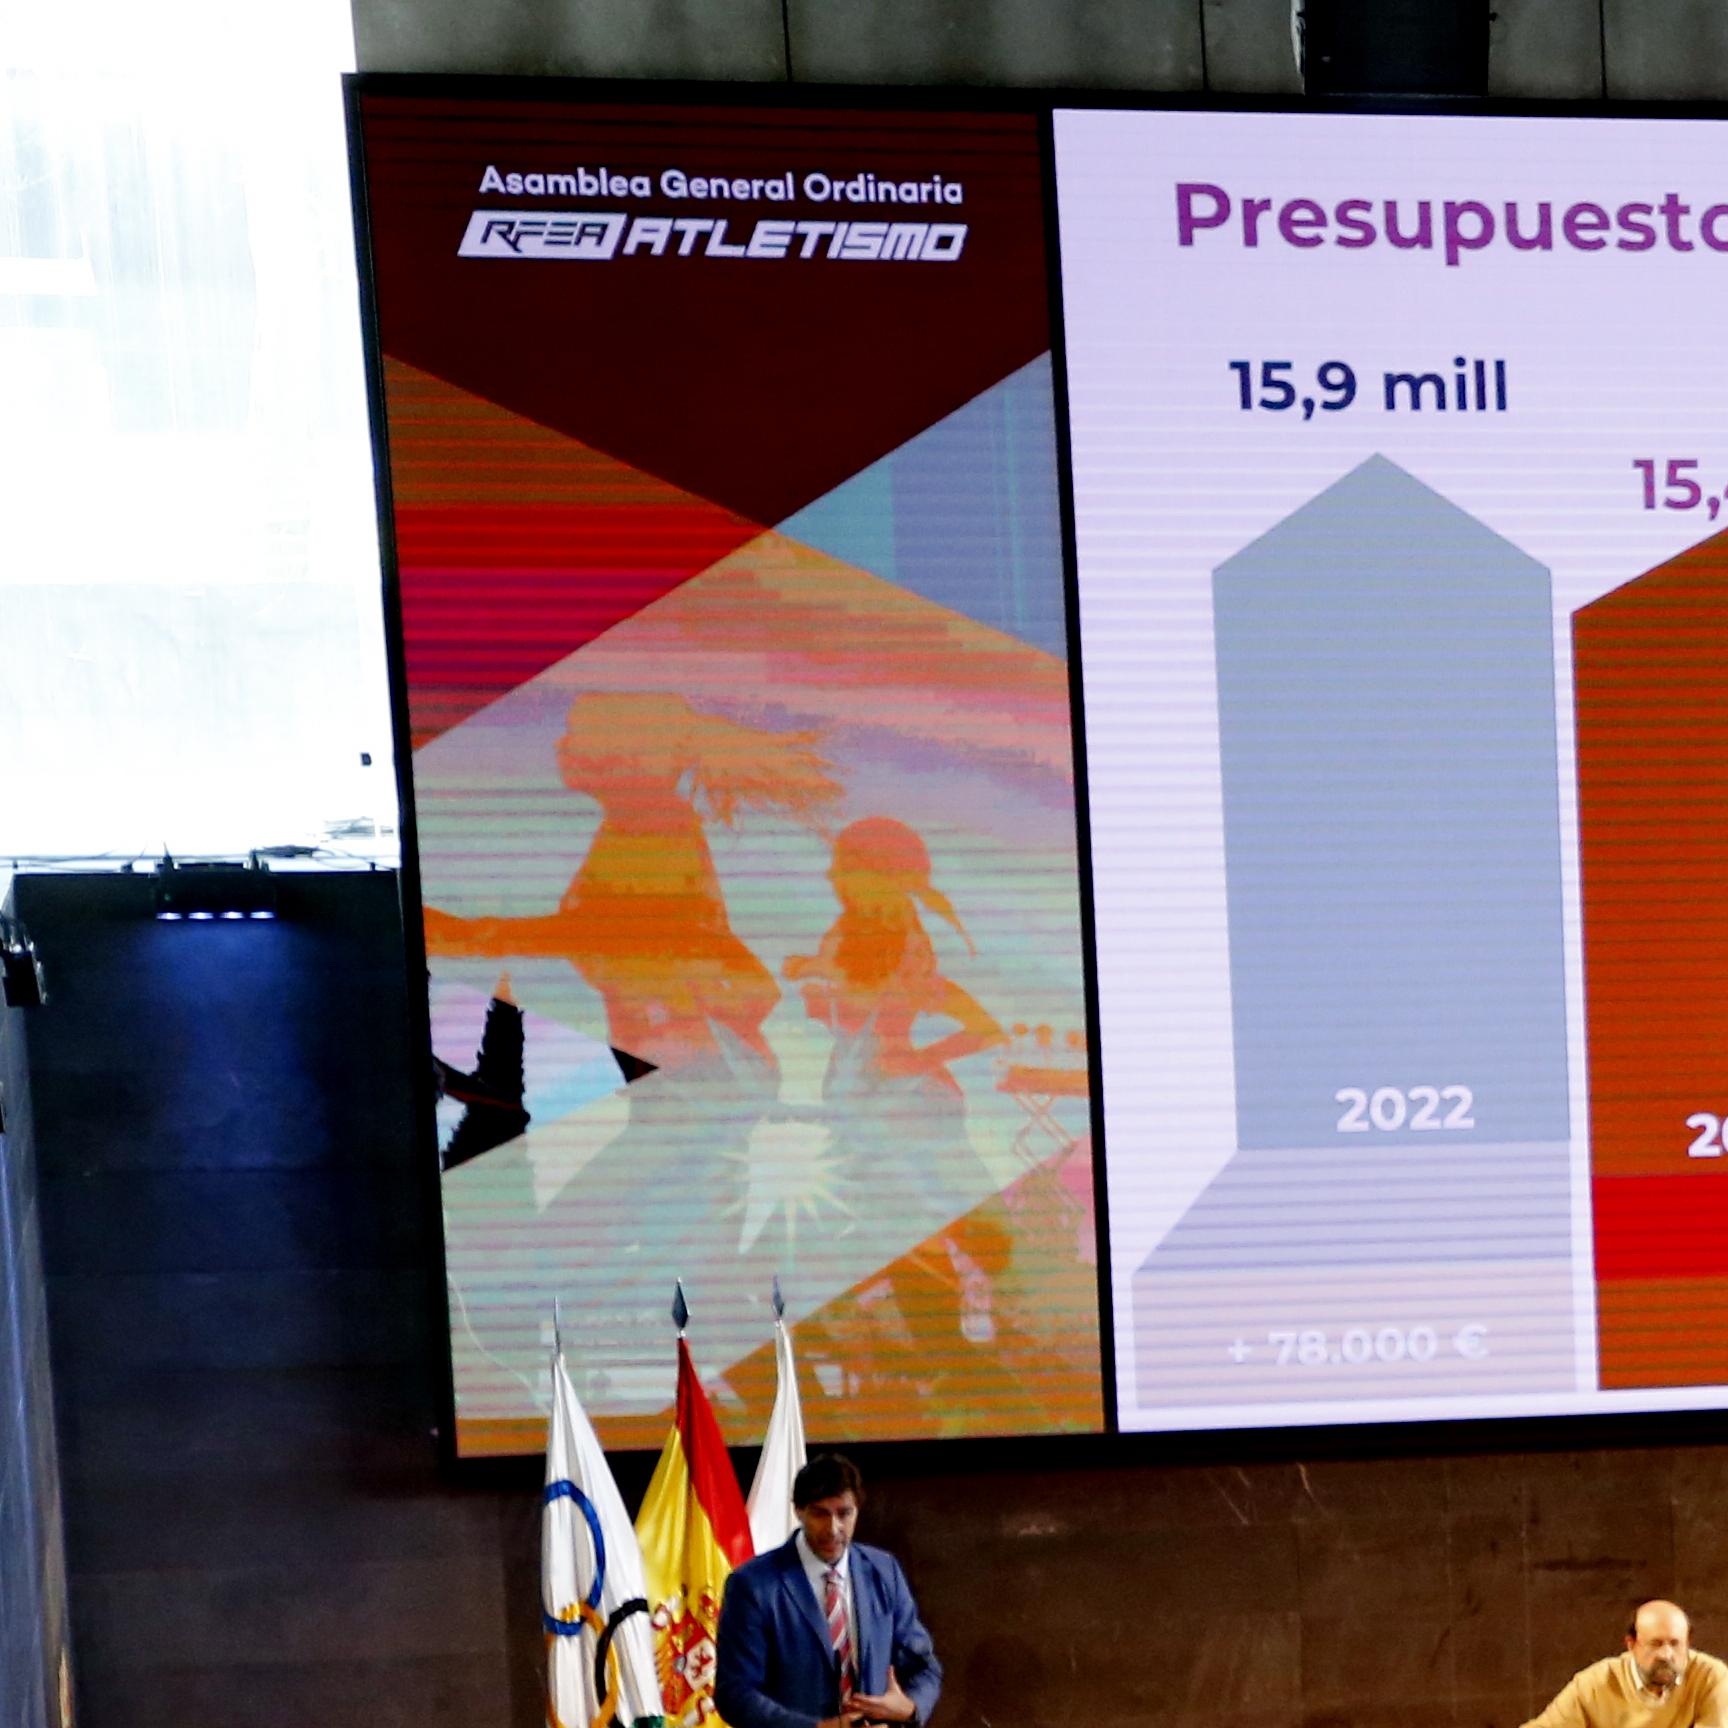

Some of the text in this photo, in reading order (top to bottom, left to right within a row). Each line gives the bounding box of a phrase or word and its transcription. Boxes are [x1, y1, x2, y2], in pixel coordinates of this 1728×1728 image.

[478, 165, 963, 204] Asamblea General Ordinaria
[478, 217, 969, 262] RFEA ATLETISMO
[1228, 355, 1508, 422] 15,9 mill
[1334, 1084, 1476, 1133] 2022
[1267, 1325, 1439, 1367] 78.000
[1451, 1321, 1490, 1361] €
